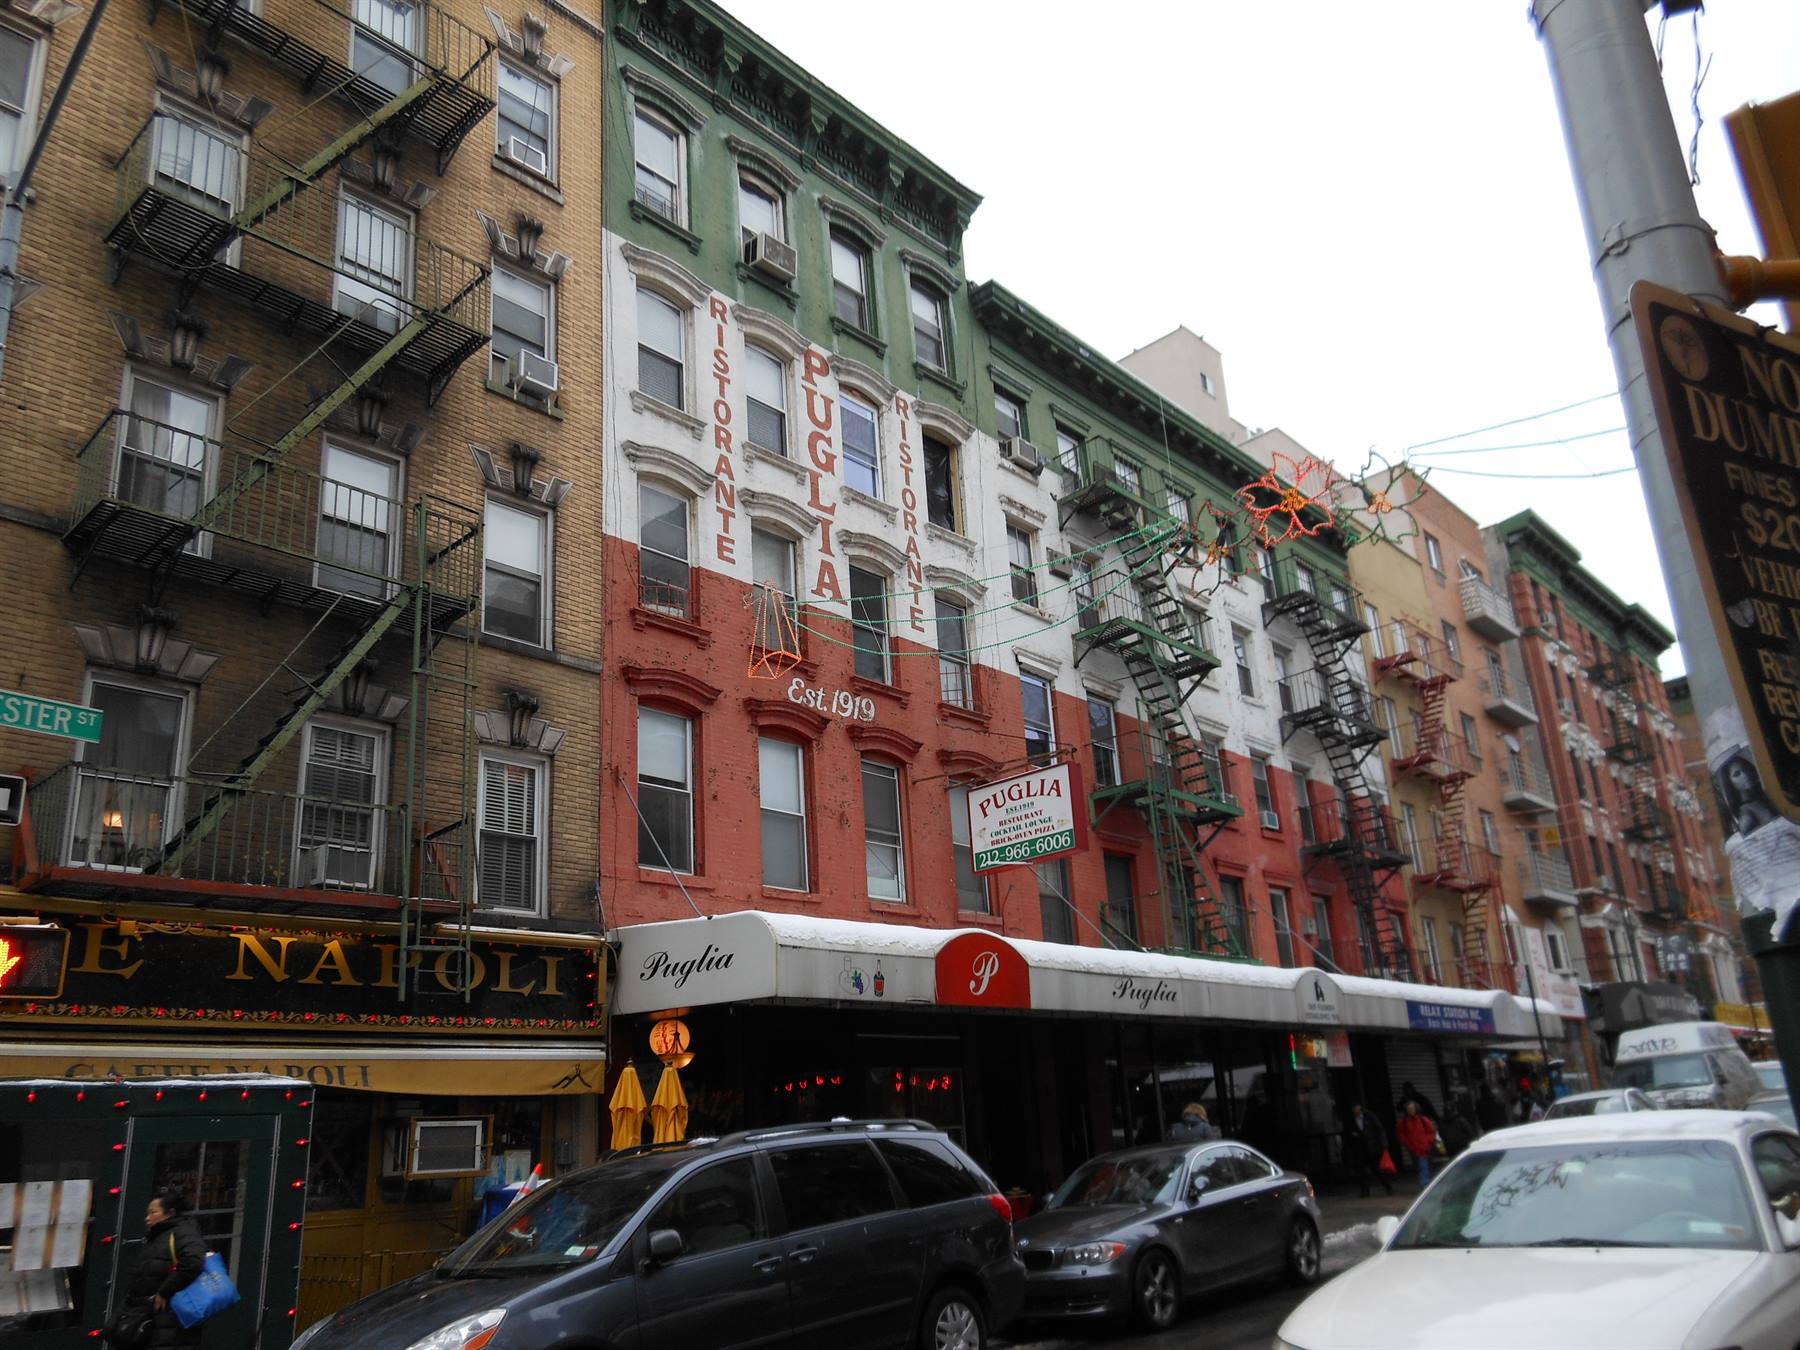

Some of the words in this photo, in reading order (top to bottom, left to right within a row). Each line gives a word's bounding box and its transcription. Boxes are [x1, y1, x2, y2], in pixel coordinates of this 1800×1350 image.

[709, 294, 737, 566] RISTORANTE
[801, 347, 849, 606] PUGLIA
[895, 394, 926, 634] RISTORANTE
[0, 694, 73, 734] STER
[77, 711, 98, 727] ST
[787, 677, 828, 712] Est.
[831, 689, 876, 722] 1919
[979, 778, 1062, 819] PUGLIA
[998, 809, 1044, 827] RESTAURANT
[990, 823, 1022, 838] COCKTAIL
[1024, 816, 1053, 829] LOUNGE
[1034, 824, 1056, 840] PIZZA
[979, 832, 1071, 868] 212-966-6006
[225, 934, 564, 997] NAPOLI
[639, 944, 734, 989] Puglia
[969, 951, 999, 995] P
[1112, 977, 1178, 1010] Puglia
